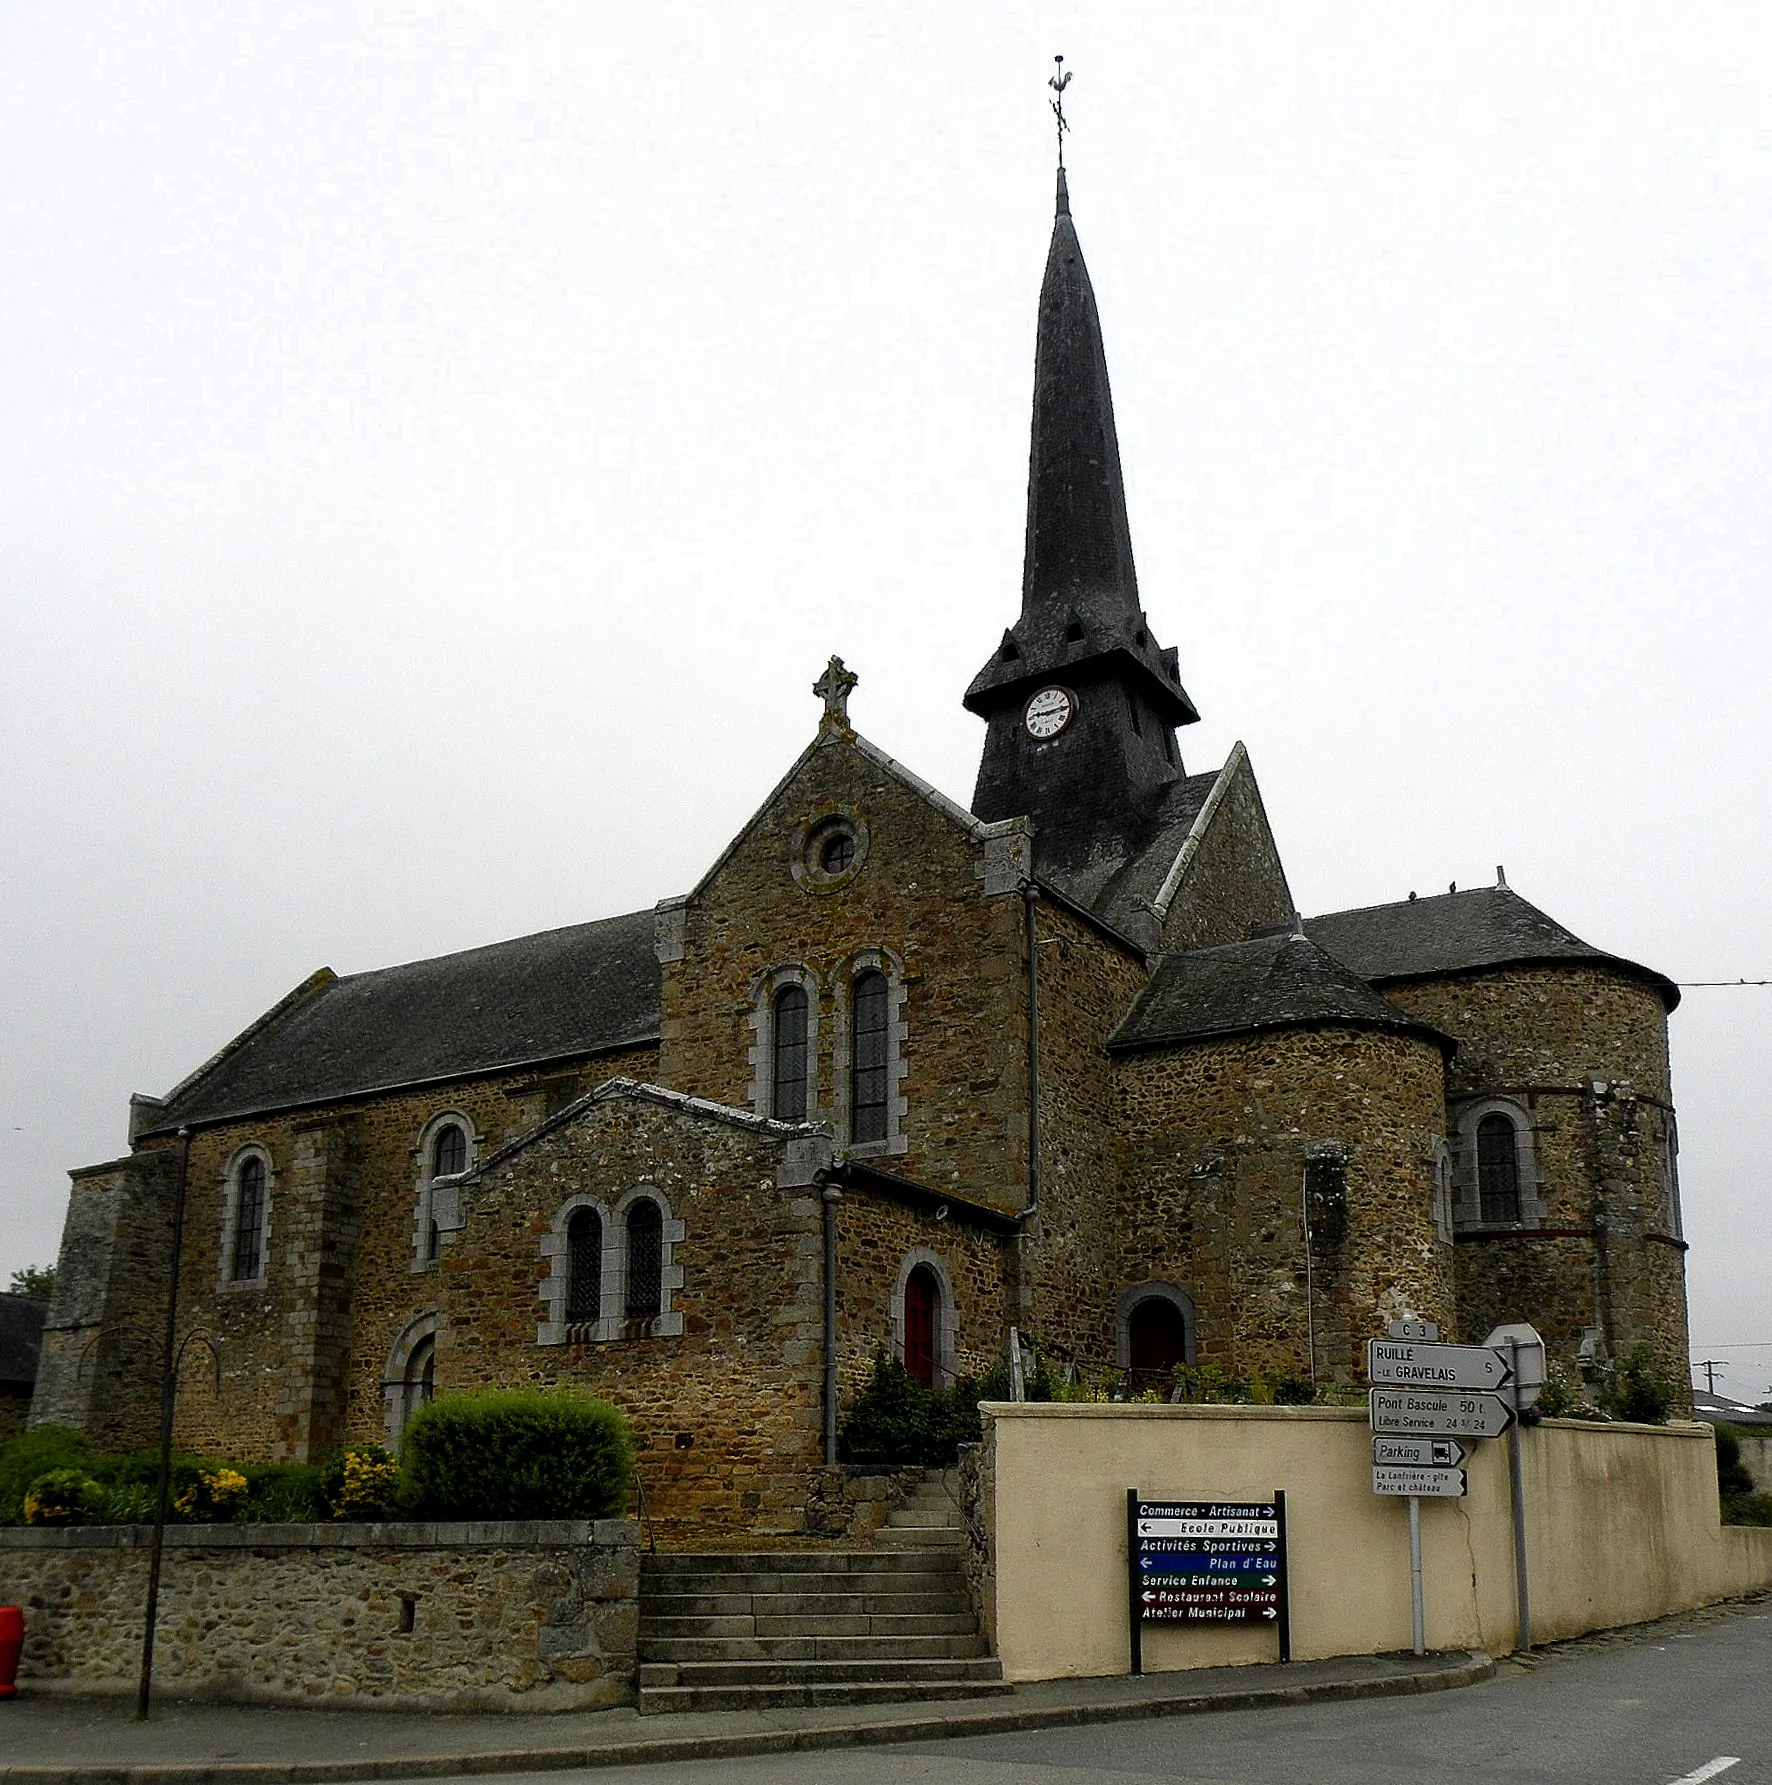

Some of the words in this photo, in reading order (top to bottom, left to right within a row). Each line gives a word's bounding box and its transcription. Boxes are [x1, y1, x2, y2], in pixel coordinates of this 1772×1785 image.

[1403, 1324, 1409, 1336] C
[1419, 1325, 1426, 1337] 3
[1377, 1347, 1414, 1361] RUILLÉ
[1396, 1366, 1456, 1381] GRAVELAIS
[1378, 1396, 1402, 1410] Pont
[1407, 1398, 1448, 1412] Bascule
[1459, 1401, 1475, 1413] 50
[1378, 1415, 1400, 1427] Libre
[1403, 1417, 1434, 1428] Service
[1446, 1418, 1457, 1429] 24
[1473, 1419, 1485, 1430] 24
[1379, 1444, 1420, 1461] Parking
[1376, 1471, 1385, 1480] La
[1376, 1482, 1394, 1491] Parc
[1409, 1483, 1440, 1492] château
[1139, 1505, 1198, 1516] Commerce
[1209, 1506, 1260, 1517] Artisanat
[1180, 1522, 1215, 1533] Ecole
[1220, 1522, 1276, 1536] Publique
[1140, 1540, 1196, 1551] Activités
[1202, 1540, 1261, 1553] Sportives
[1209, 1558, 1236, 1569] Plan
[1142, 1575, 1187, 1586] Service
[1191, 1575, 1238, 1586] Enfance
[1159, 1591, 1224, 1602] Restaurant
[1228, 1591, 1277, 1602] Scolaire
[1142, 1607, 1184, 1618] Atelier
[1188, 1607, 1246, 1619] Municipal
